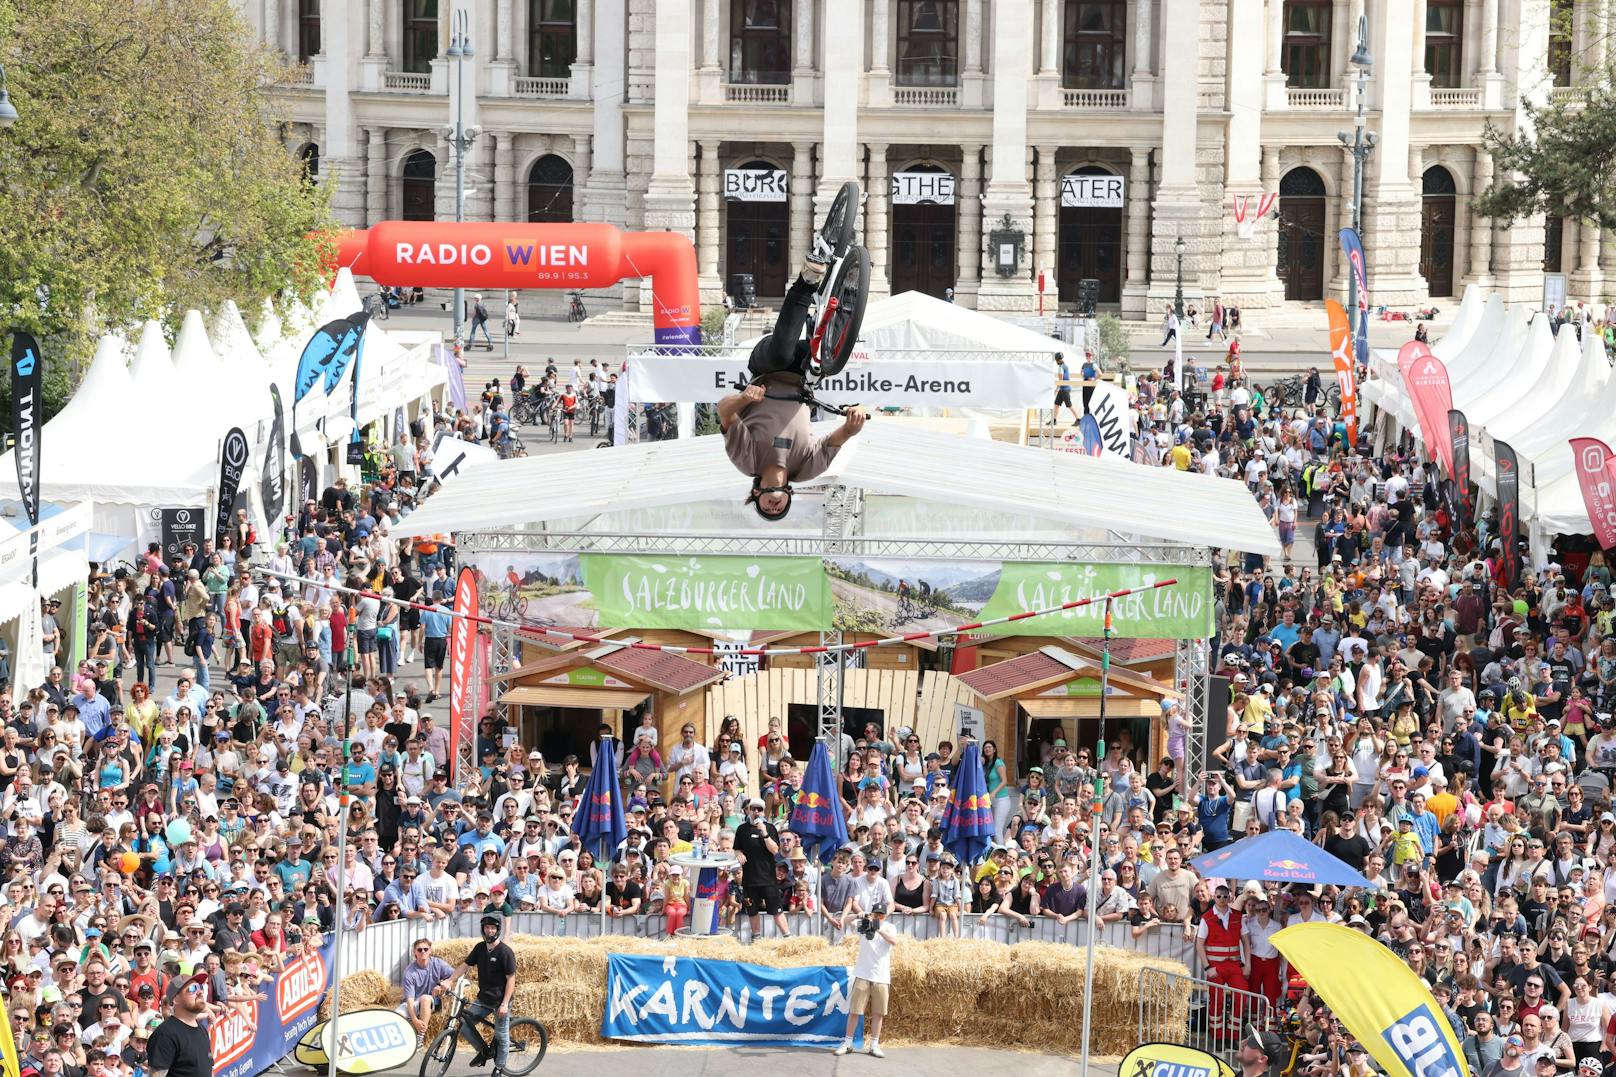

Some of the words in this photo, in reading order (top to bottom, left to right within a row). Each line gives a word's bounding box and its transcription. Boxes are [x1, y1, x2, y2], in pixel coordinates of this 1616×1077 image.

[396, 243, 491, 265] RADIO
[507, 245, 587, 266] WIEN
[758, 576, 806, 611] LAND
[452, 580, 471, 715] FLACHAU
[1264, 869, 1289, 877] Red
[1291, 870, 1315, 879] Bull
